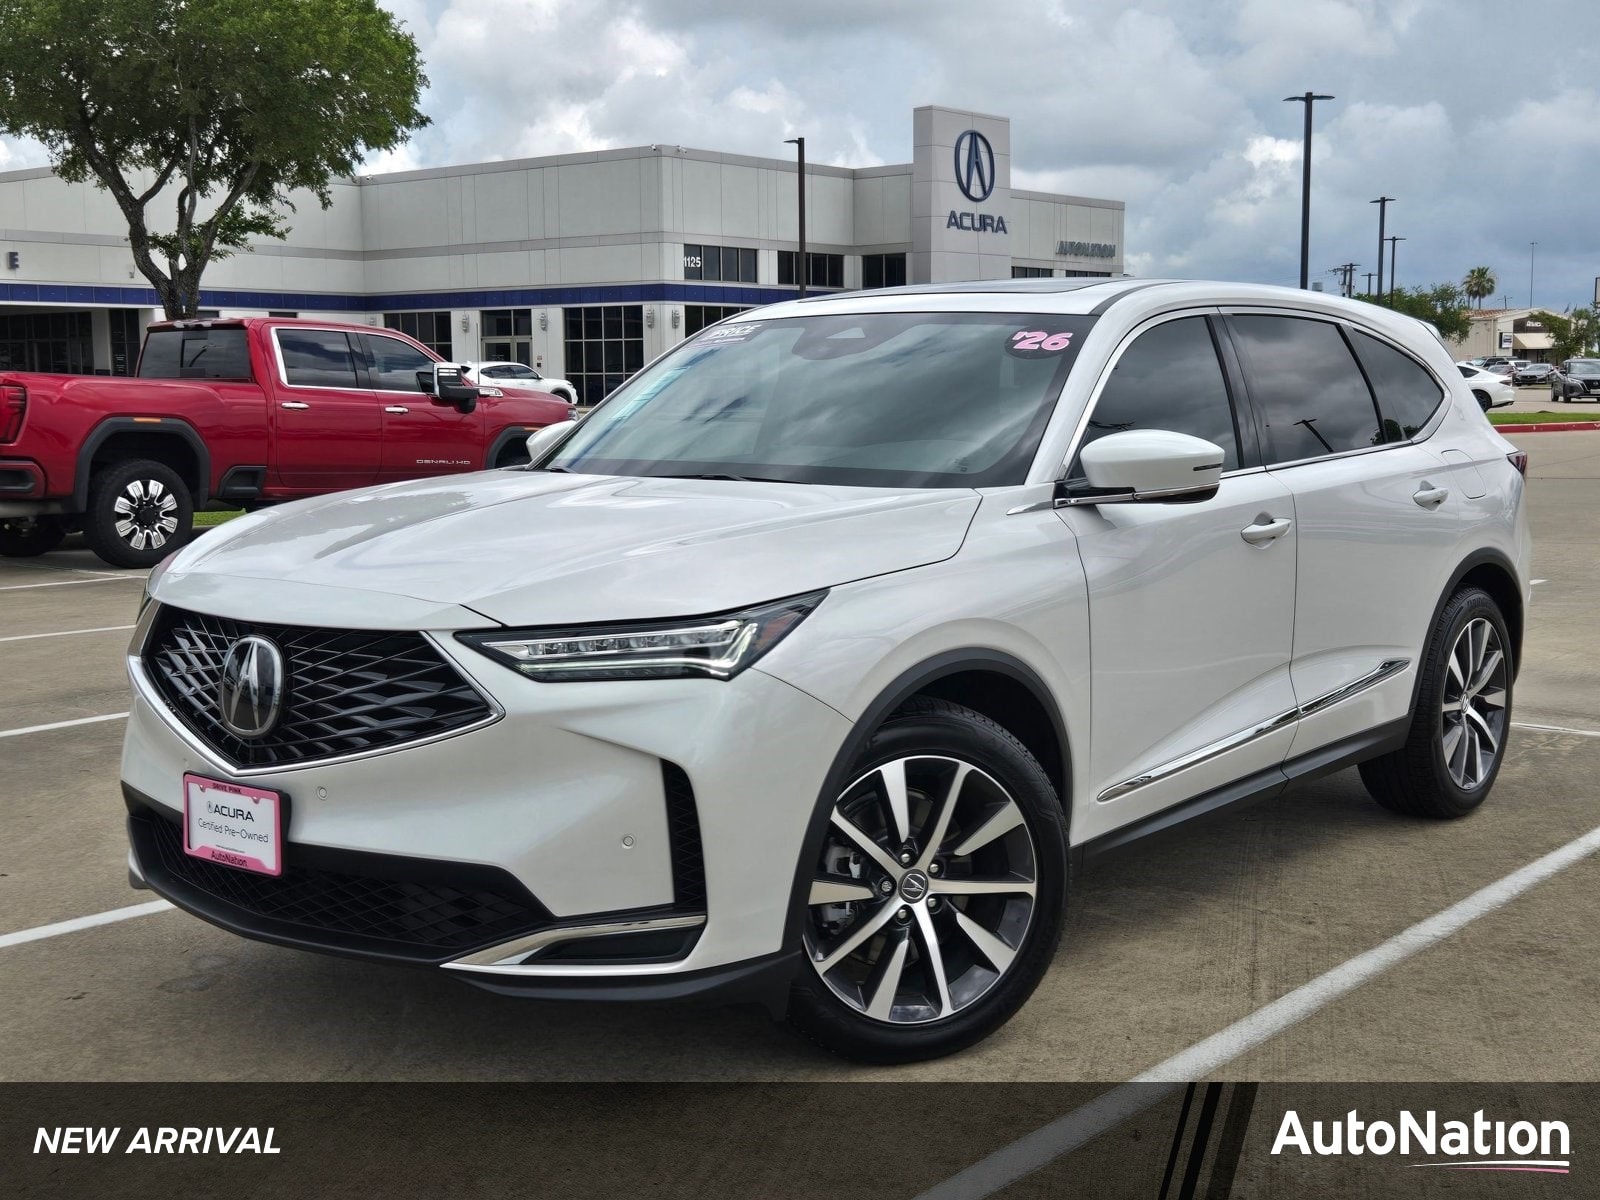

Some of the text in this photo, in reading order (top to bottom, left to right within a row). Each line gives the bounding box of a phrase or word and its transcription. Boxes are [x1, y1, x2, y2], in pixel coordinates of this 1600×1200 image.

[946, 210, 1008, 234] ACURA
[7, 251, 19, 270] E
[683, 256, 702, 268] 1125
[213, 804, 255, 822] ACURA
[198, 818, 269, 843] Certified Pre-Owned
[211, 851, 248, 868] AutoNation
